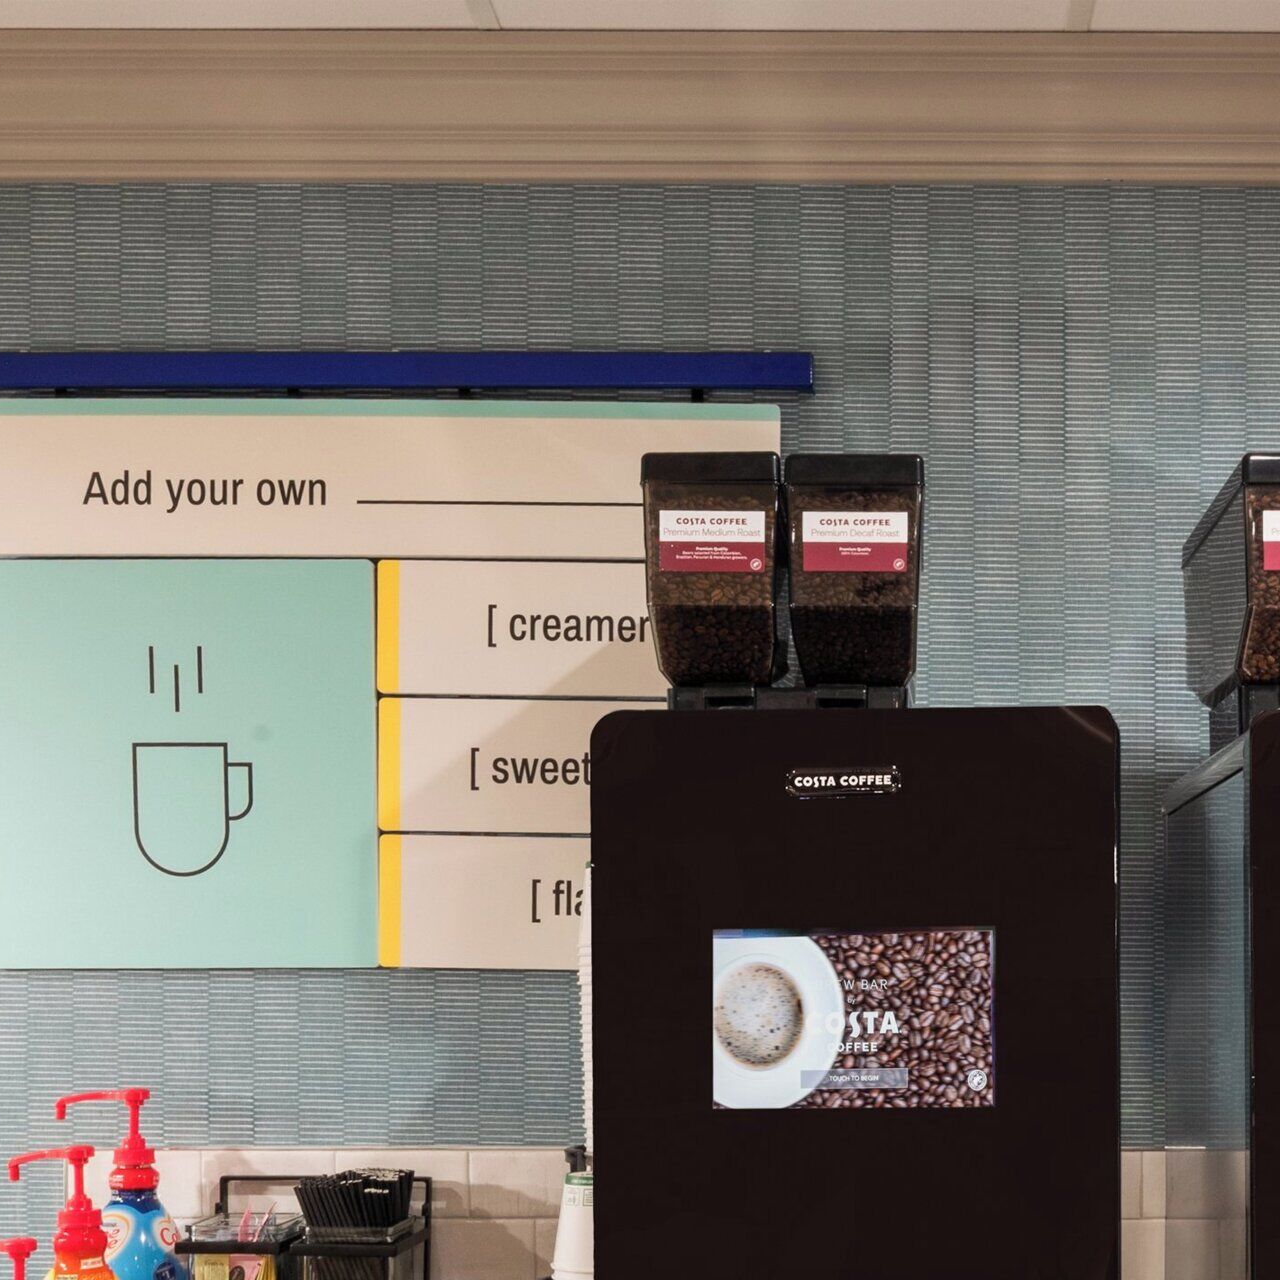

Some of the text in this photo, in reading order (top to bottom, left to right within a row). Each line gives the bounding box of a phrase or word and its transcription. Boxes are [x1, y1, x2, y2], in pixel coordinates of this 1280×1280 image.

[82, 470, 327, 513] Add your own
[509, 612, 650, 643] creamer
[491, 751, 591, 786] sweet
[794, 774, 893, 787] COSTA COFFEE
[861, 979, 888, 991] BAR
[829, 1074, 880, 1082] TOUCH TO BEGIN
